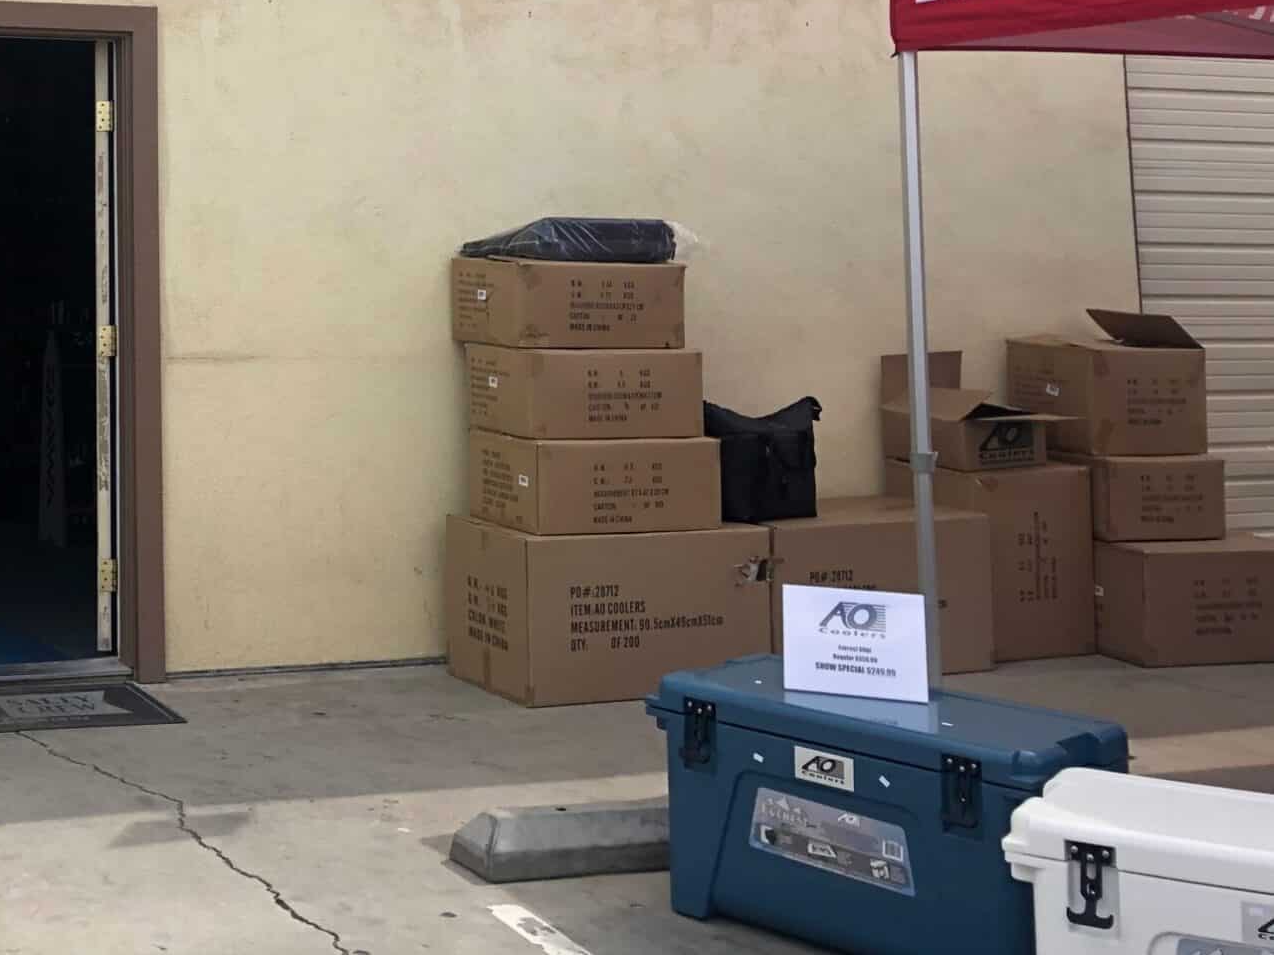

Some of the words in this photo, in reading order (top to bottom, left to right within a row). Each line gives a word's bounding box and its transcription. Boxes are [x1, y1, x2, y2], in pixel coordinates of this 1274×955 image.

[607, 600, 646, 615] COOLERS
[623, 635, 641, 648] 200
[838, 663, 865, 674] SPECIAL
